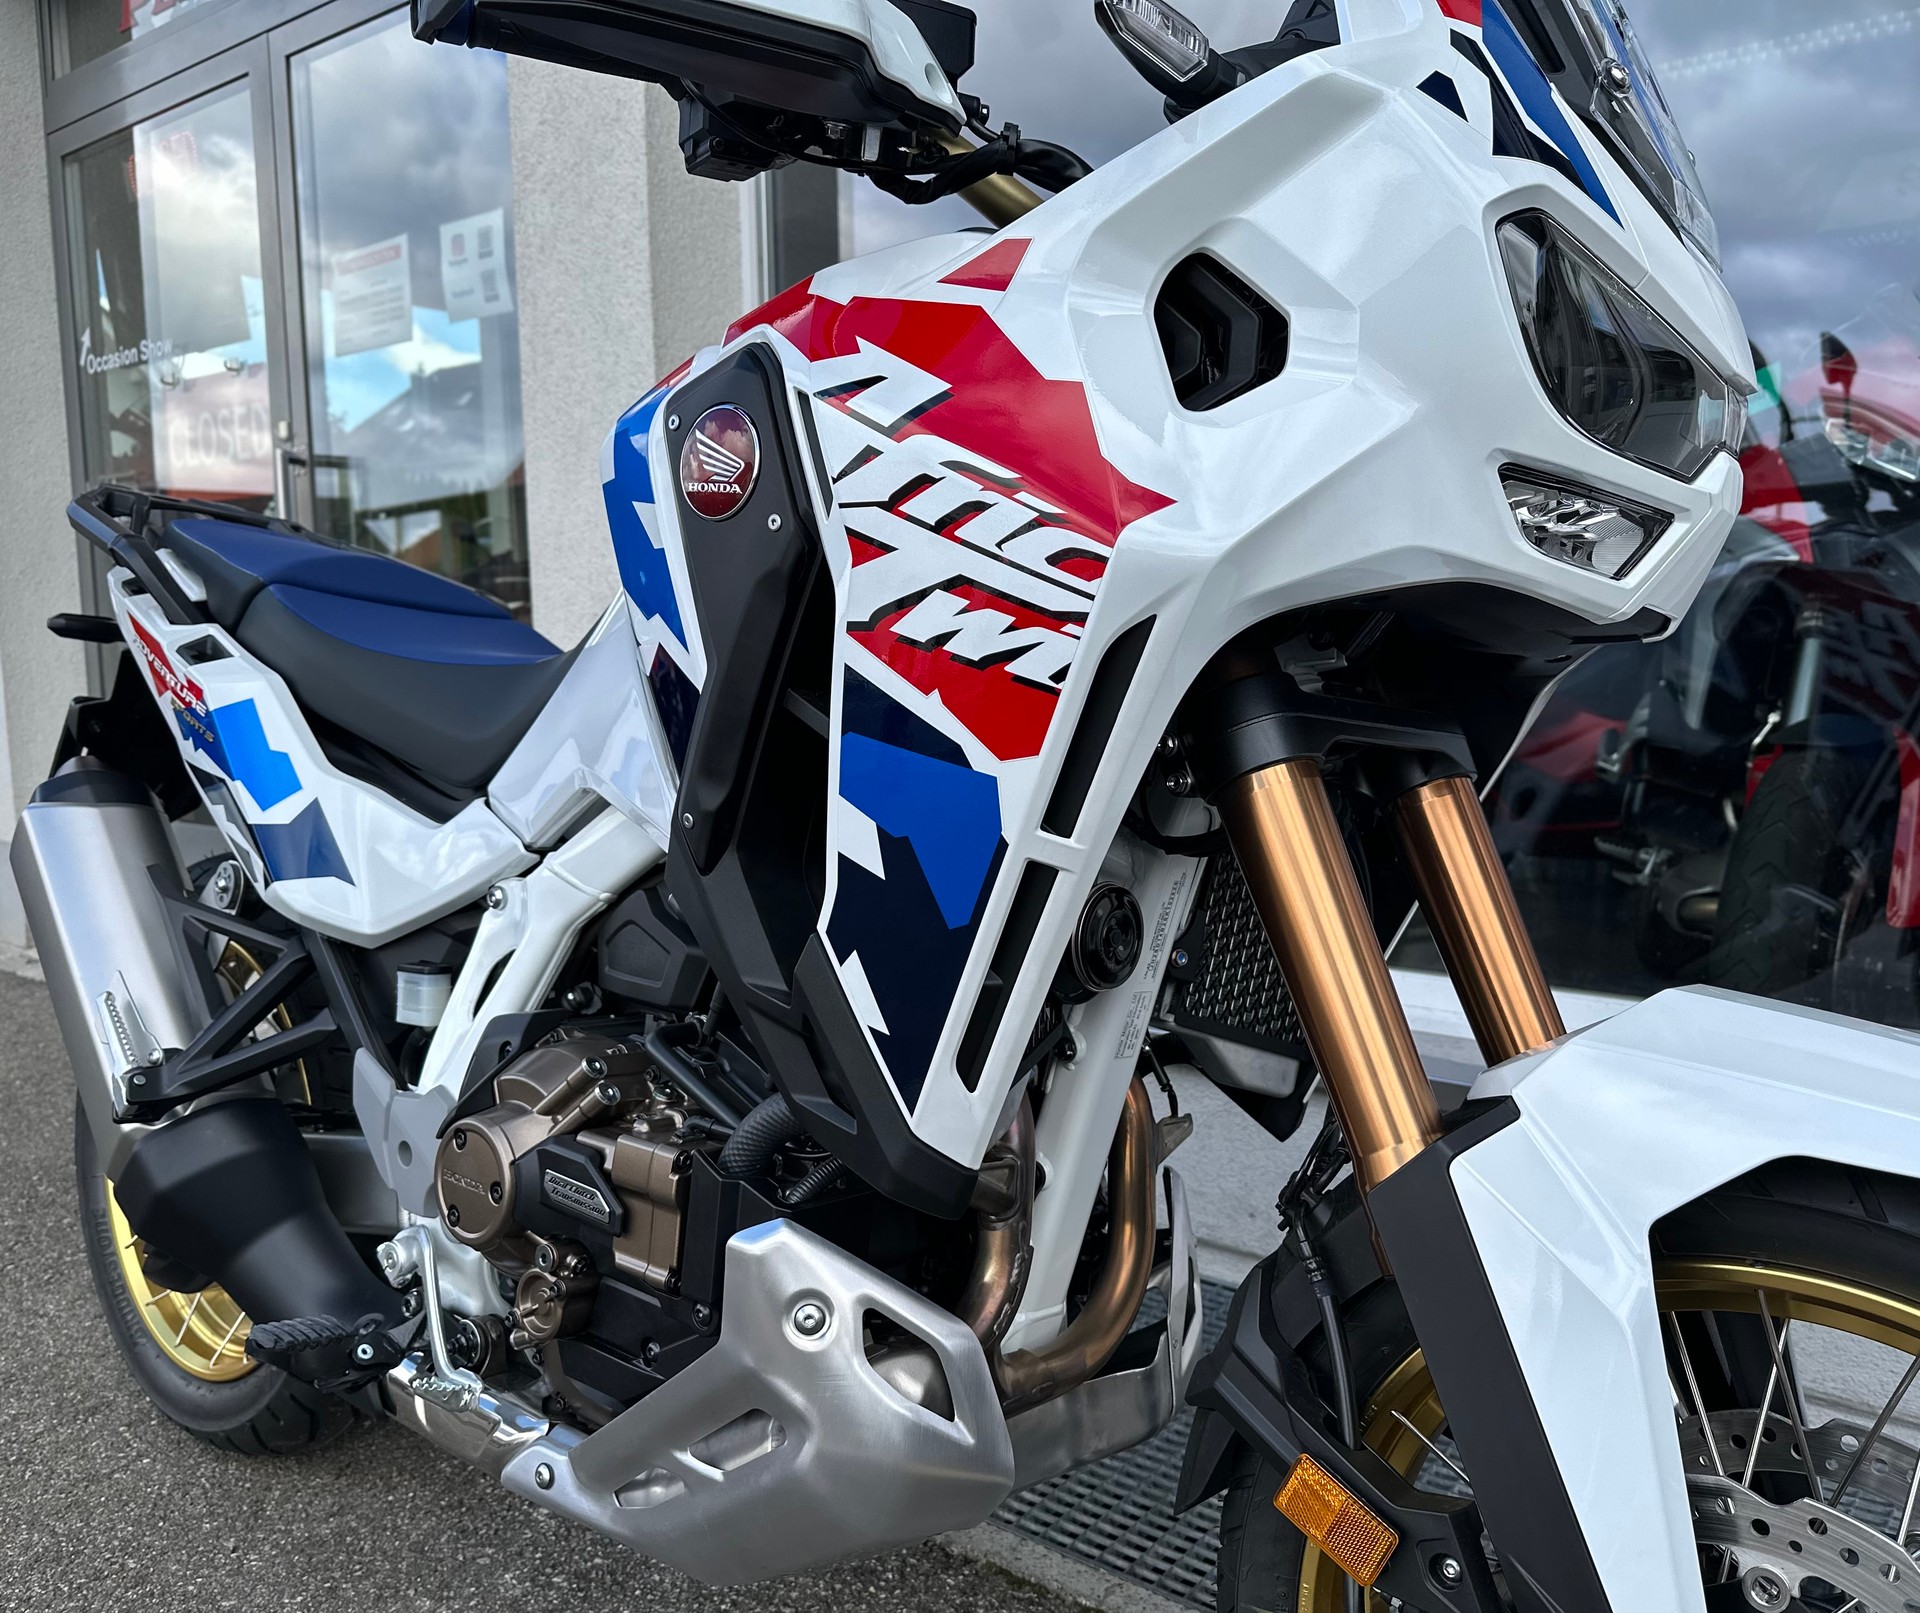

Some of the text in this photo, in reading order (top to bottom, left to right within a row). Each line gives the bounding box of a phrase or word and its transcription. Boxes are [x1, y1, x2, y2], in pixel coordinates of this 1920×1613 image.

[86, 338, 173, 374] Occasion Show
[168, 403, 268, 467] CLOSED
[687, 482, 743, 495] HONDA
[133, 635, 208, 718] ADVENTURE
[171, 697, 215, 742] SPORTS
[443, 1168, 486, 1195] HONDA
[548, 1175, 596, 1201] Dual Clutch
[550, 1187, 606, 1216] Transmission
